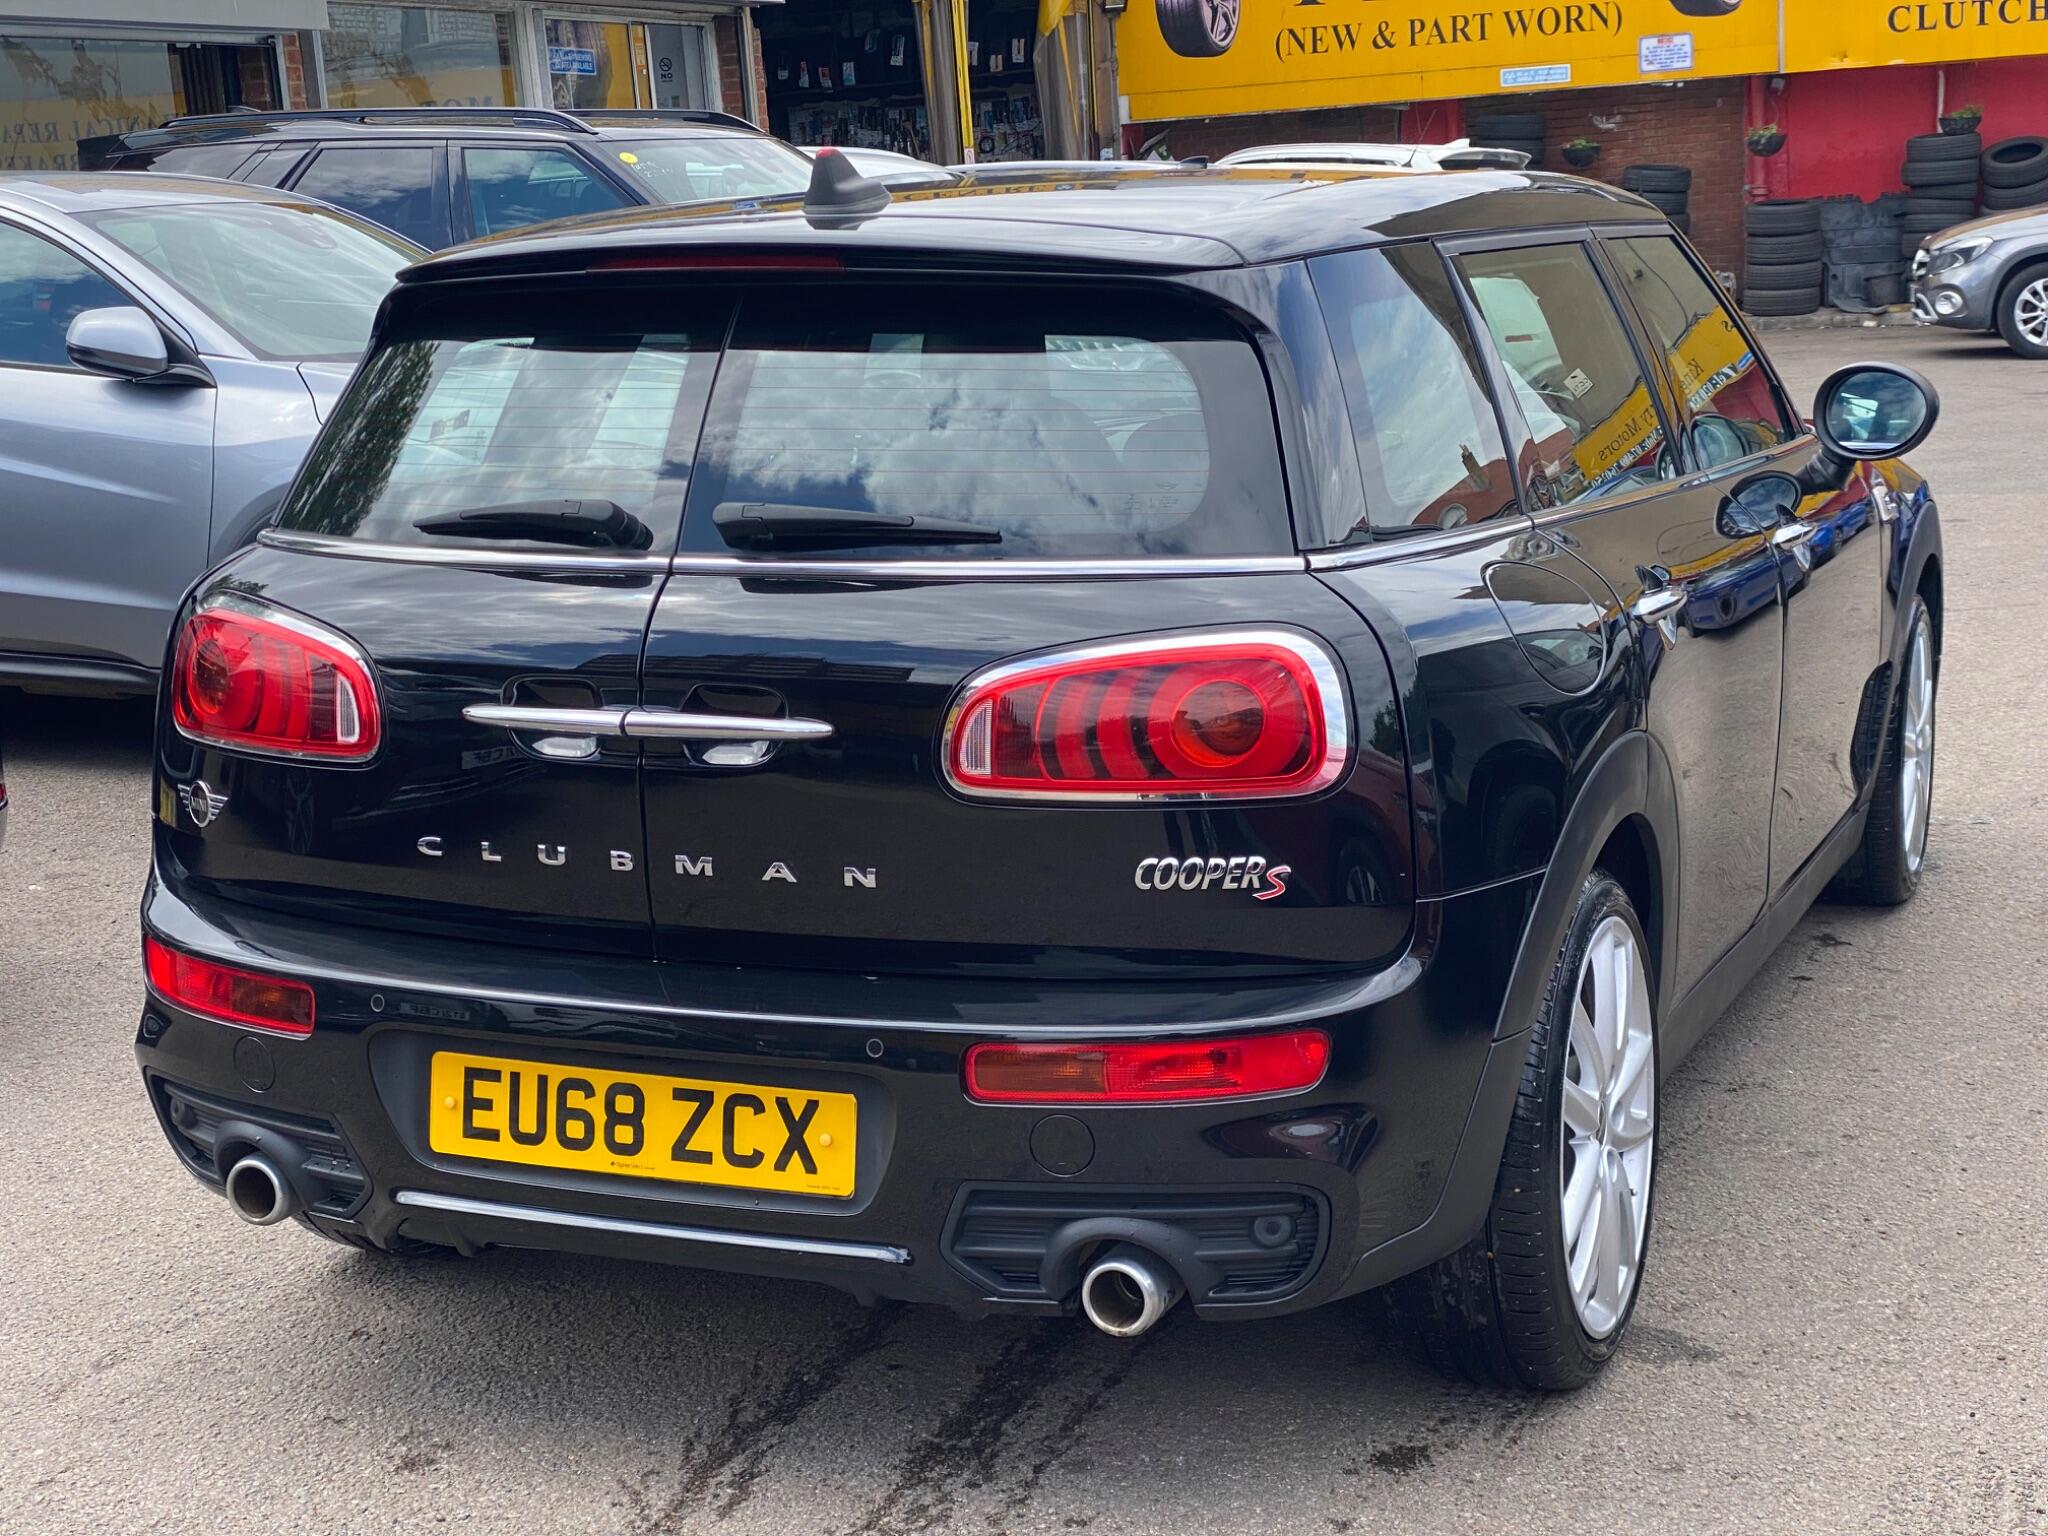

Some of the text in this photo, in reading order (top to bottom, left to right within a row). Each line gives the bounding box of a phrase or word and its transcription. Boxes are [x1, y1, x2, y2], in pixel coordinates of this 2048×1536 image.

[1275, 1, 1623, 63] (NEW & PART WORN)
[417, 836, 877, 889] CLUBMAN
[1134, 856, 1266, 891] COOPER
[462, 1066, 820, 1175] EU68 ZCX
